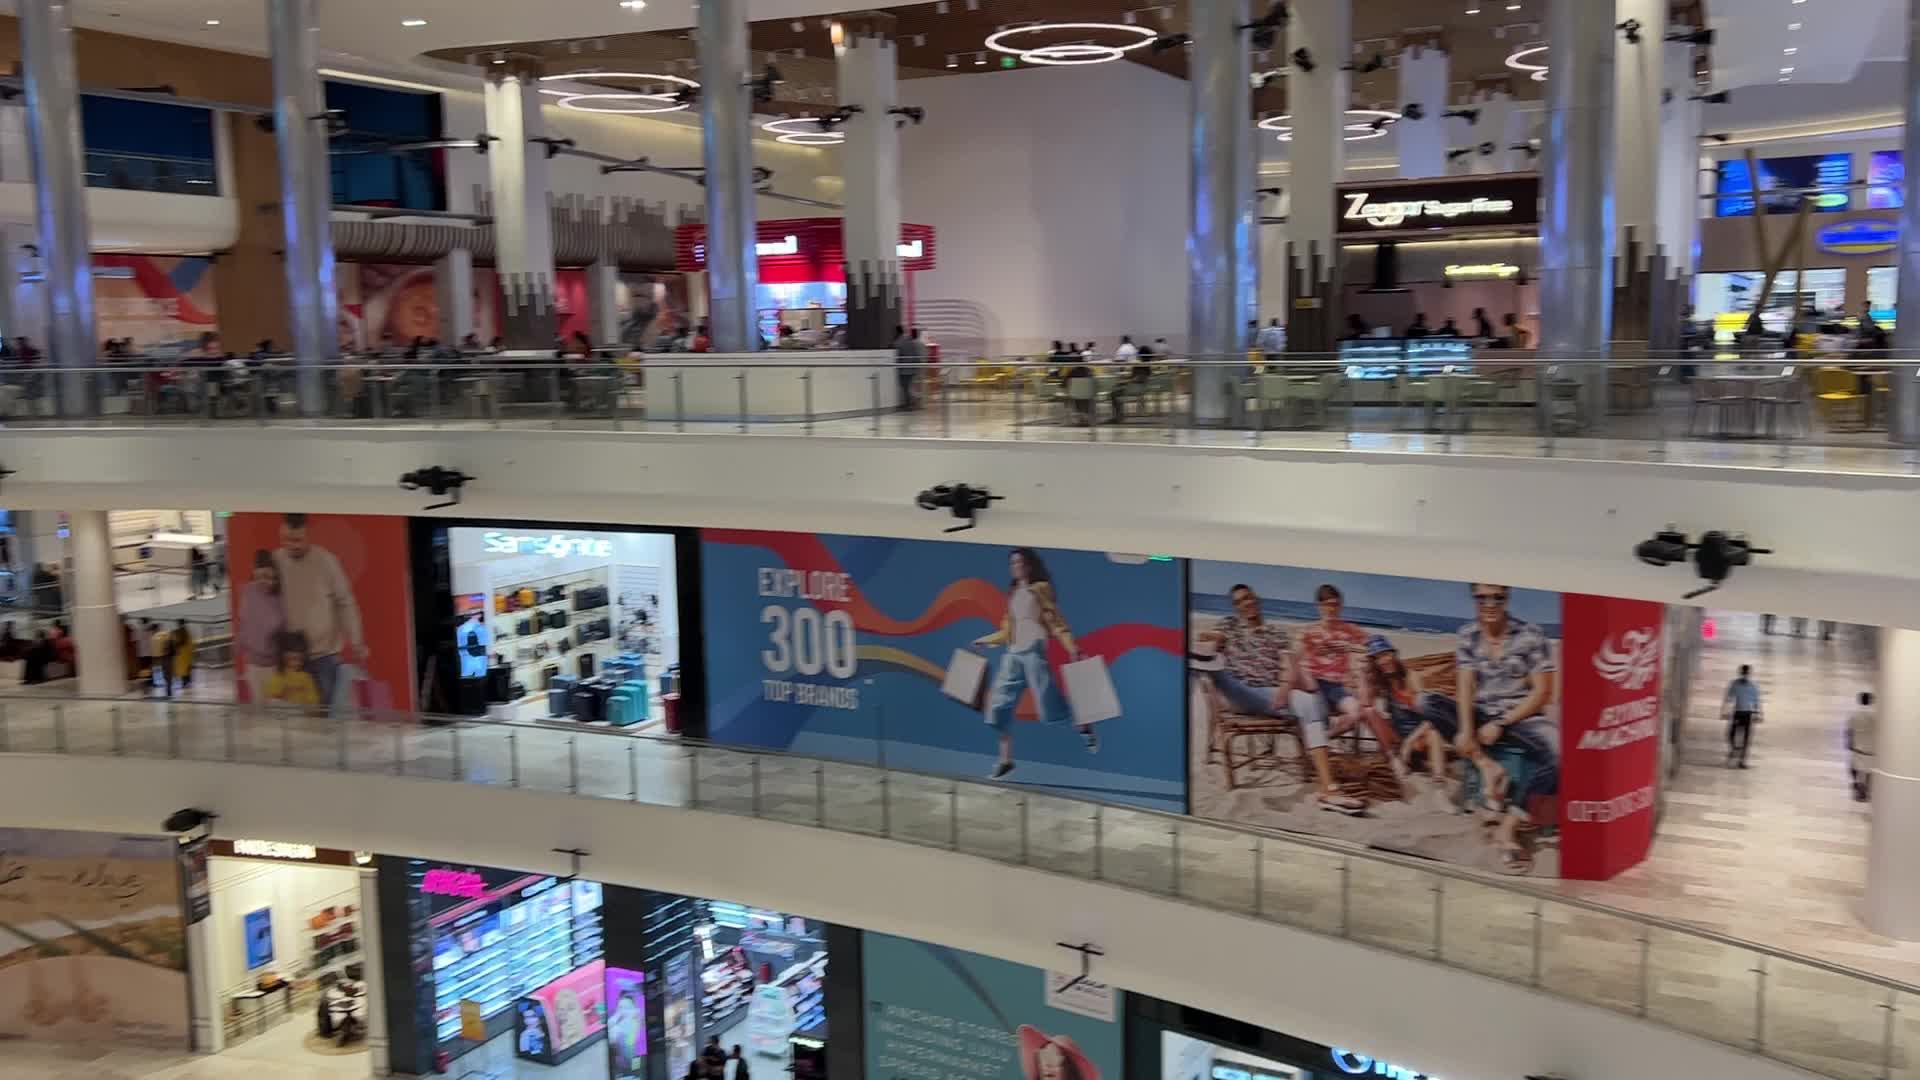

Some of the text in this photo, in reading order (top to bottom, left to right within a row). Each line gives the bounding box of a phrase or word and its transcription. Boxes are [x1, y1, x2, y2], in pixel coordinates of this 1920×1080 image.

[758, 567, 853, 602] EXPLORE
[760, 605, 857, 679] 300
[762, 679, 859, 710] TOP BRANDS
